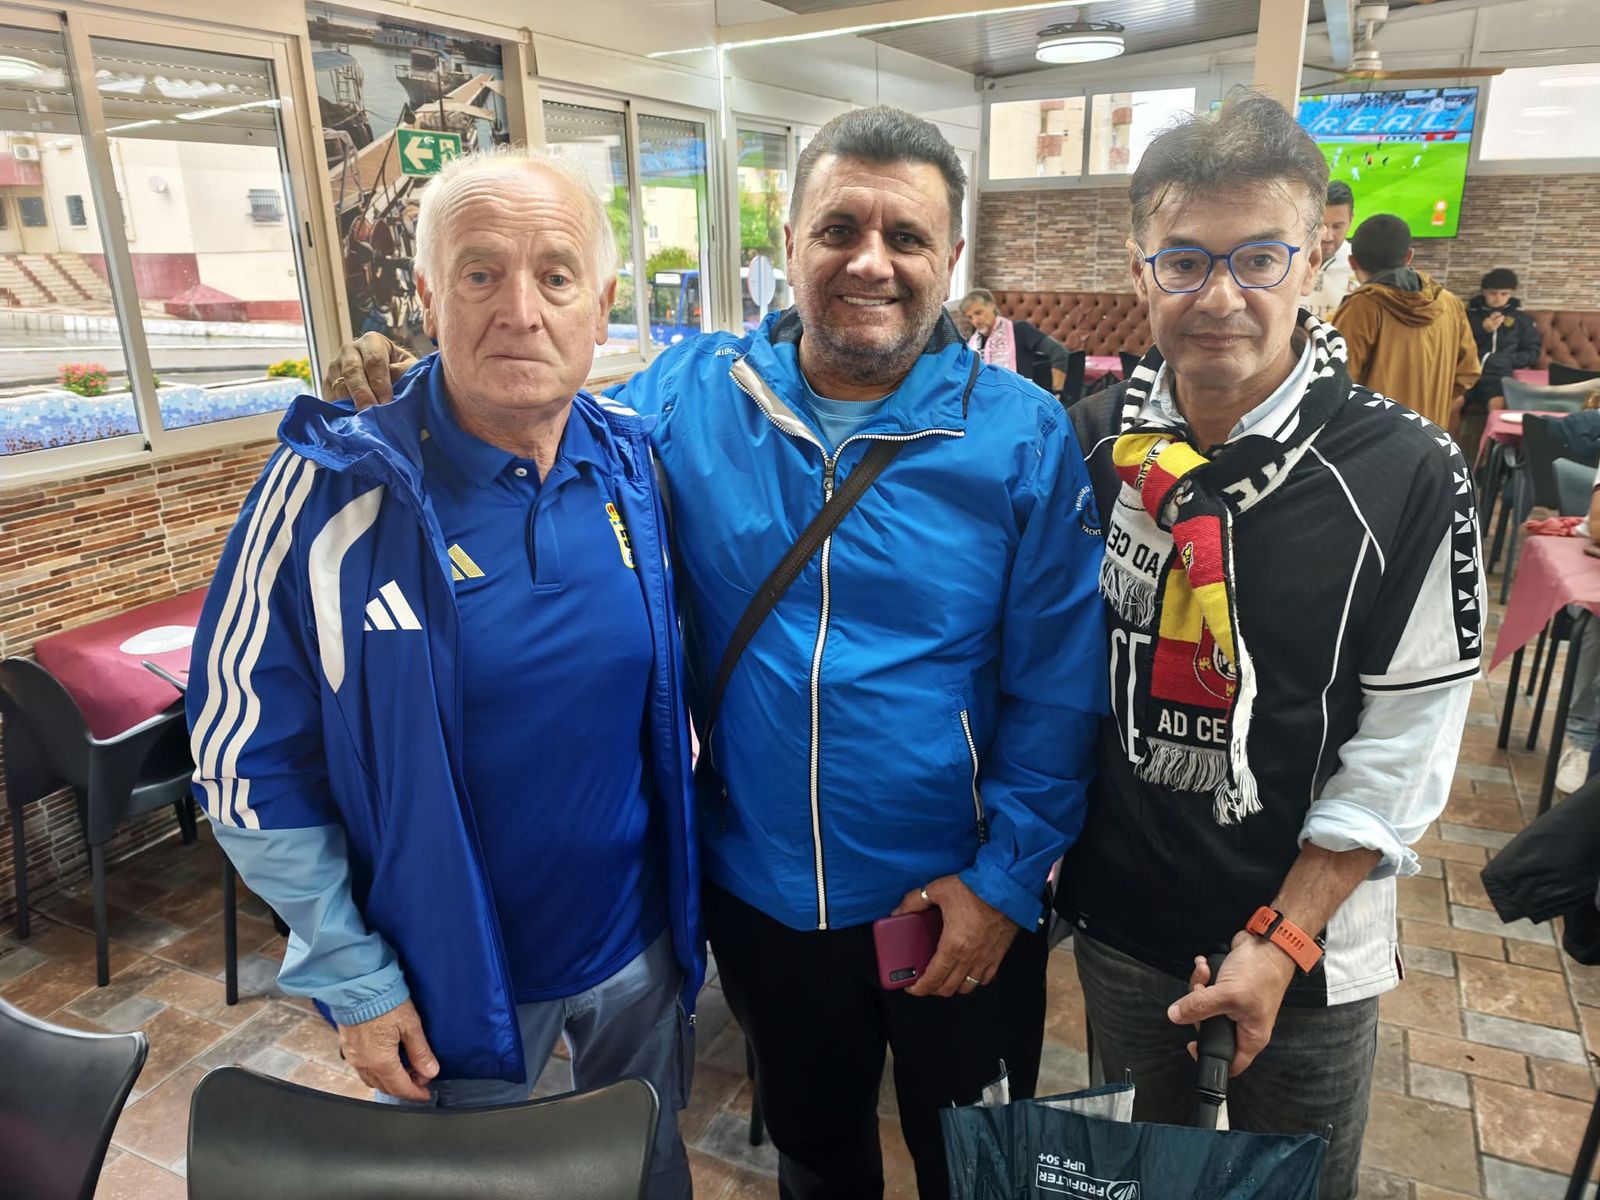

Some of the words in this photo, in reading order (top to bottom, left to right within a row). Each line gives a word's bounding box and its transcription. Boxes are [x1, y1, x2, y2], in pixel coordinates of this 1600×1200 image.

[1082, 524, 1102, 536] YACHT
[1157, 708, 1188, 737] AD
[1038, 1152, 1060, 1165] 50+
[1063, 1158, 1086, 1172] UPF
[1038, 1171, 1105, 1197] PROFILTER
